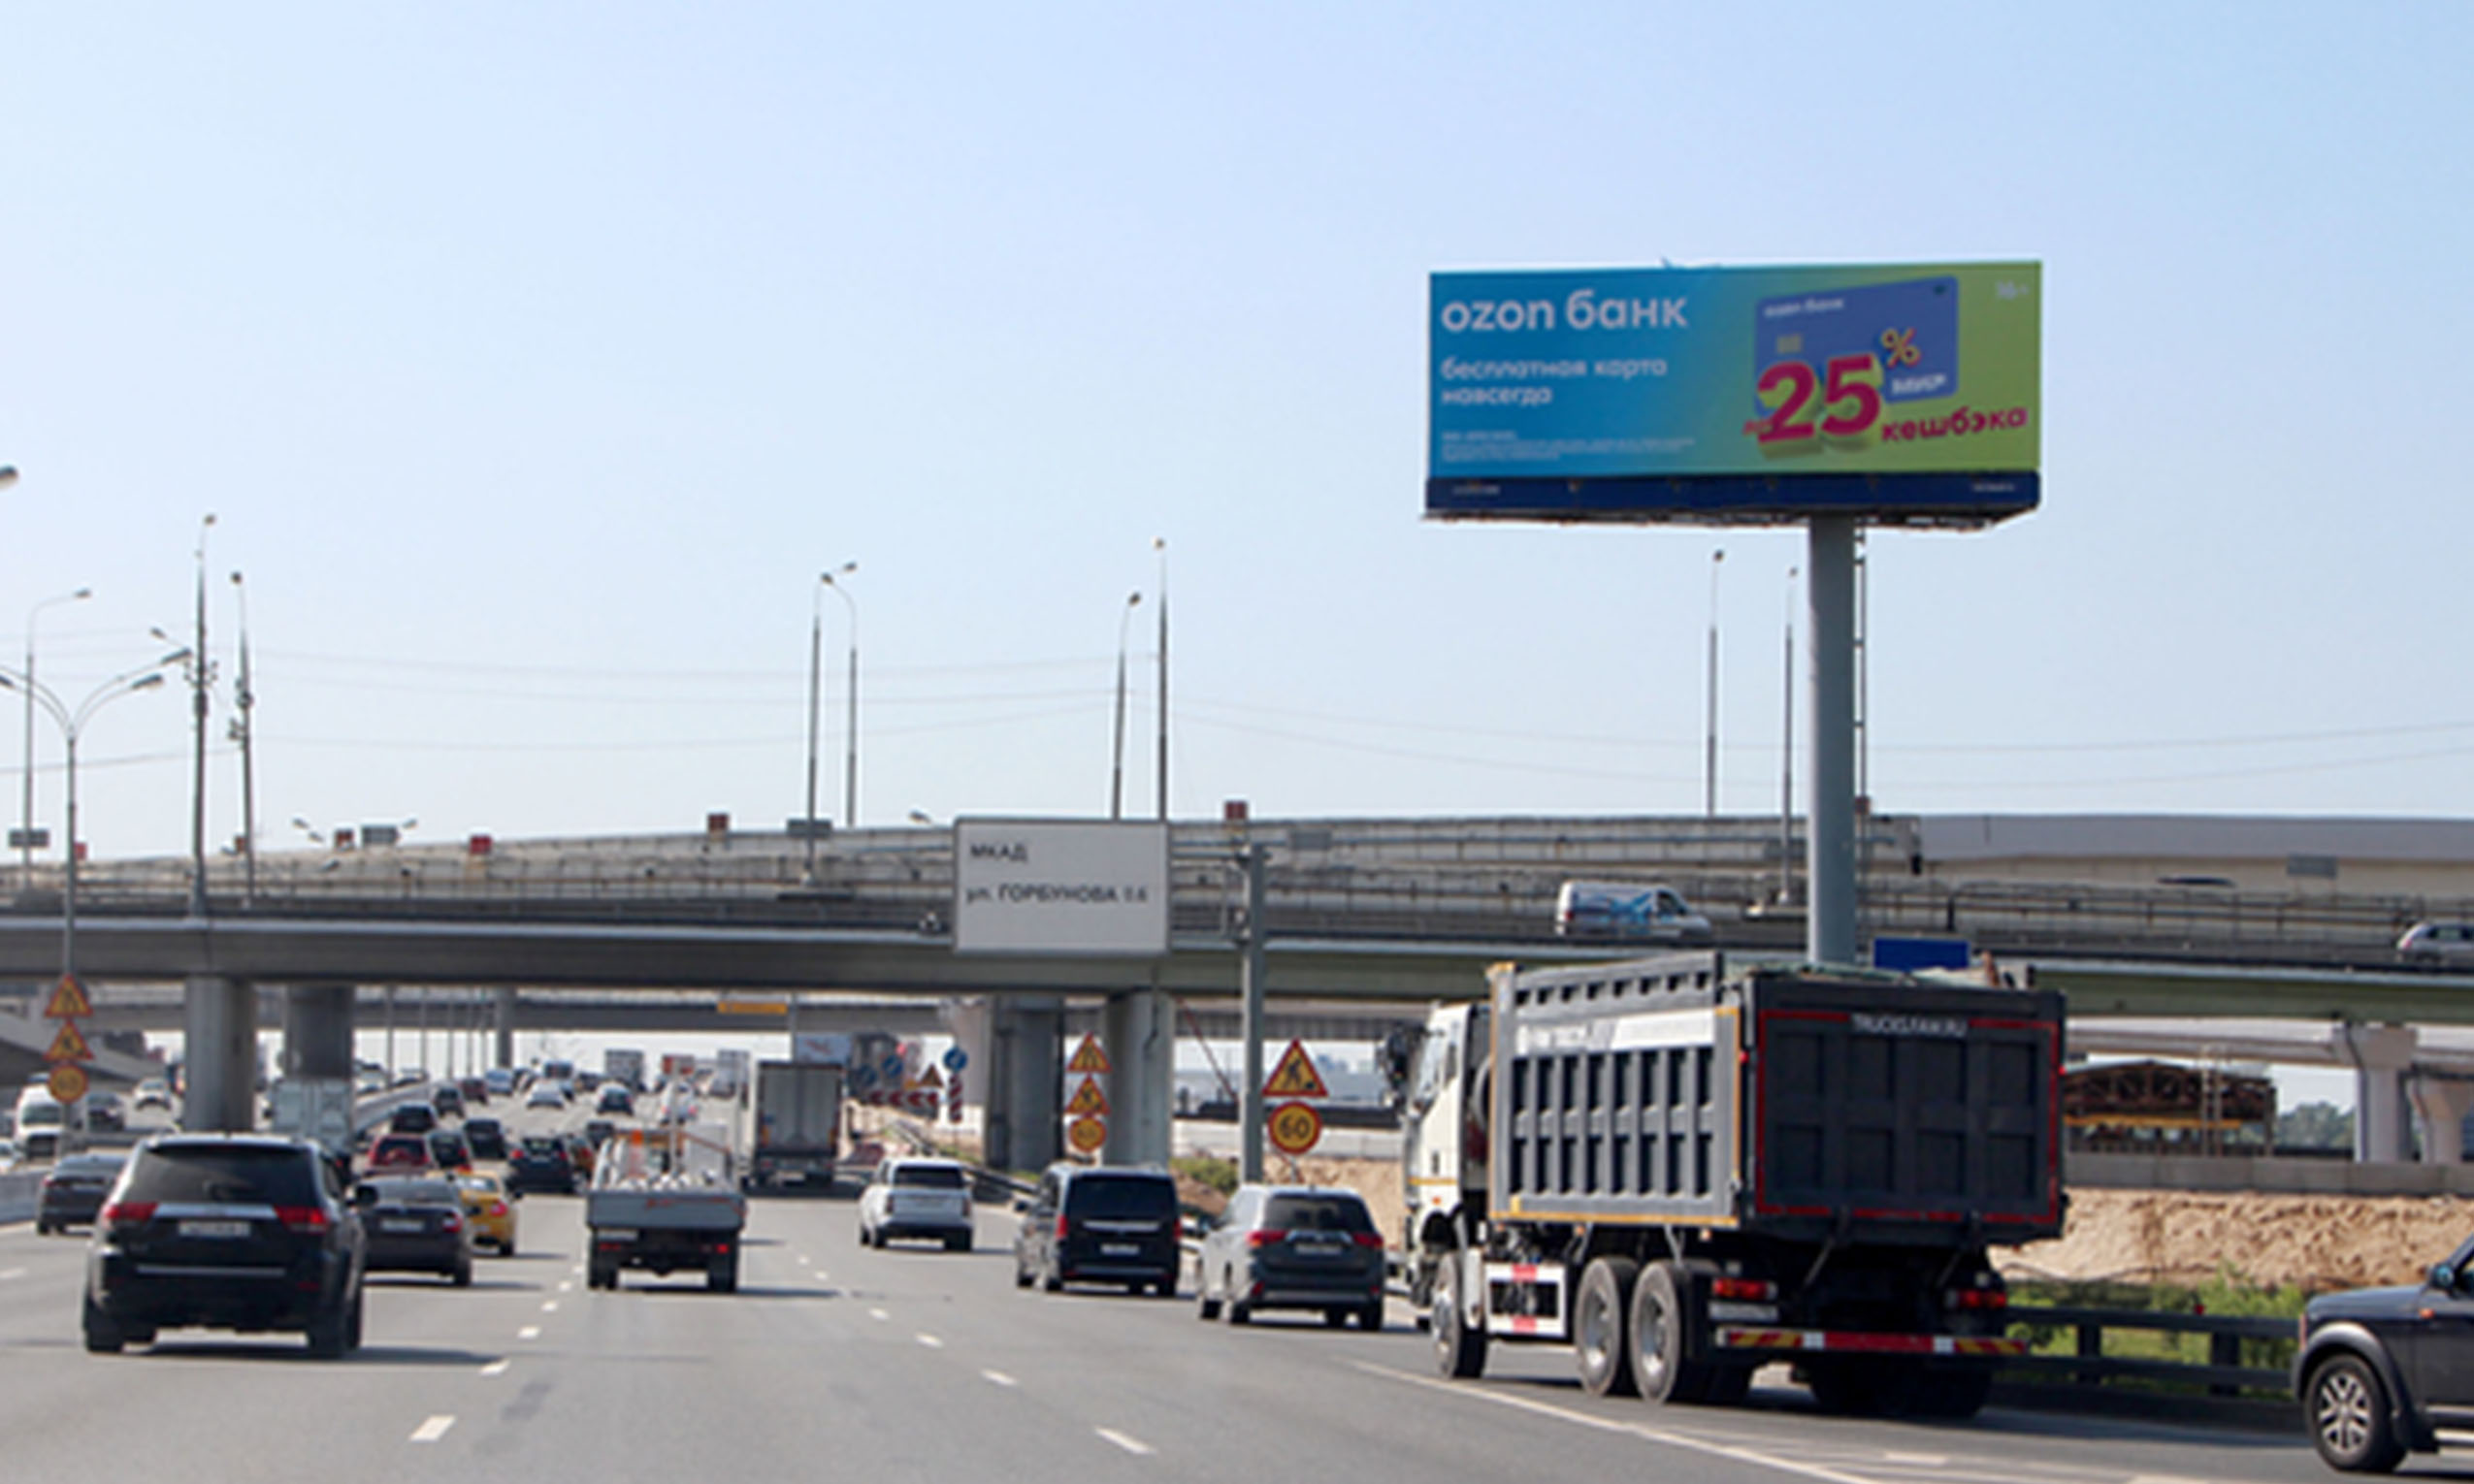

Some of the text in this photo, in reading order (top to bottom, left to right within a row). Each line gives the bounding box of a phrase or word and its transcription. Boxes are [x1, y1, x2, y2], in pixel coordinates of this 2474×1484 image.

[1441, 288, 1689, 333] ozon банк
[1441, 356, 1668, 381] бесплатная карта
[1441, 387, 1552, 406] навсегда
[1757, 354, 1882, 443] 25
[1880, 405, 2029, 442] кешбэка
[971, 844, 1027, 862] МКАД
[997, 884, 1119, 902] ГОРБУНОВА
[1280, 1114, 1311, 1139] 60
